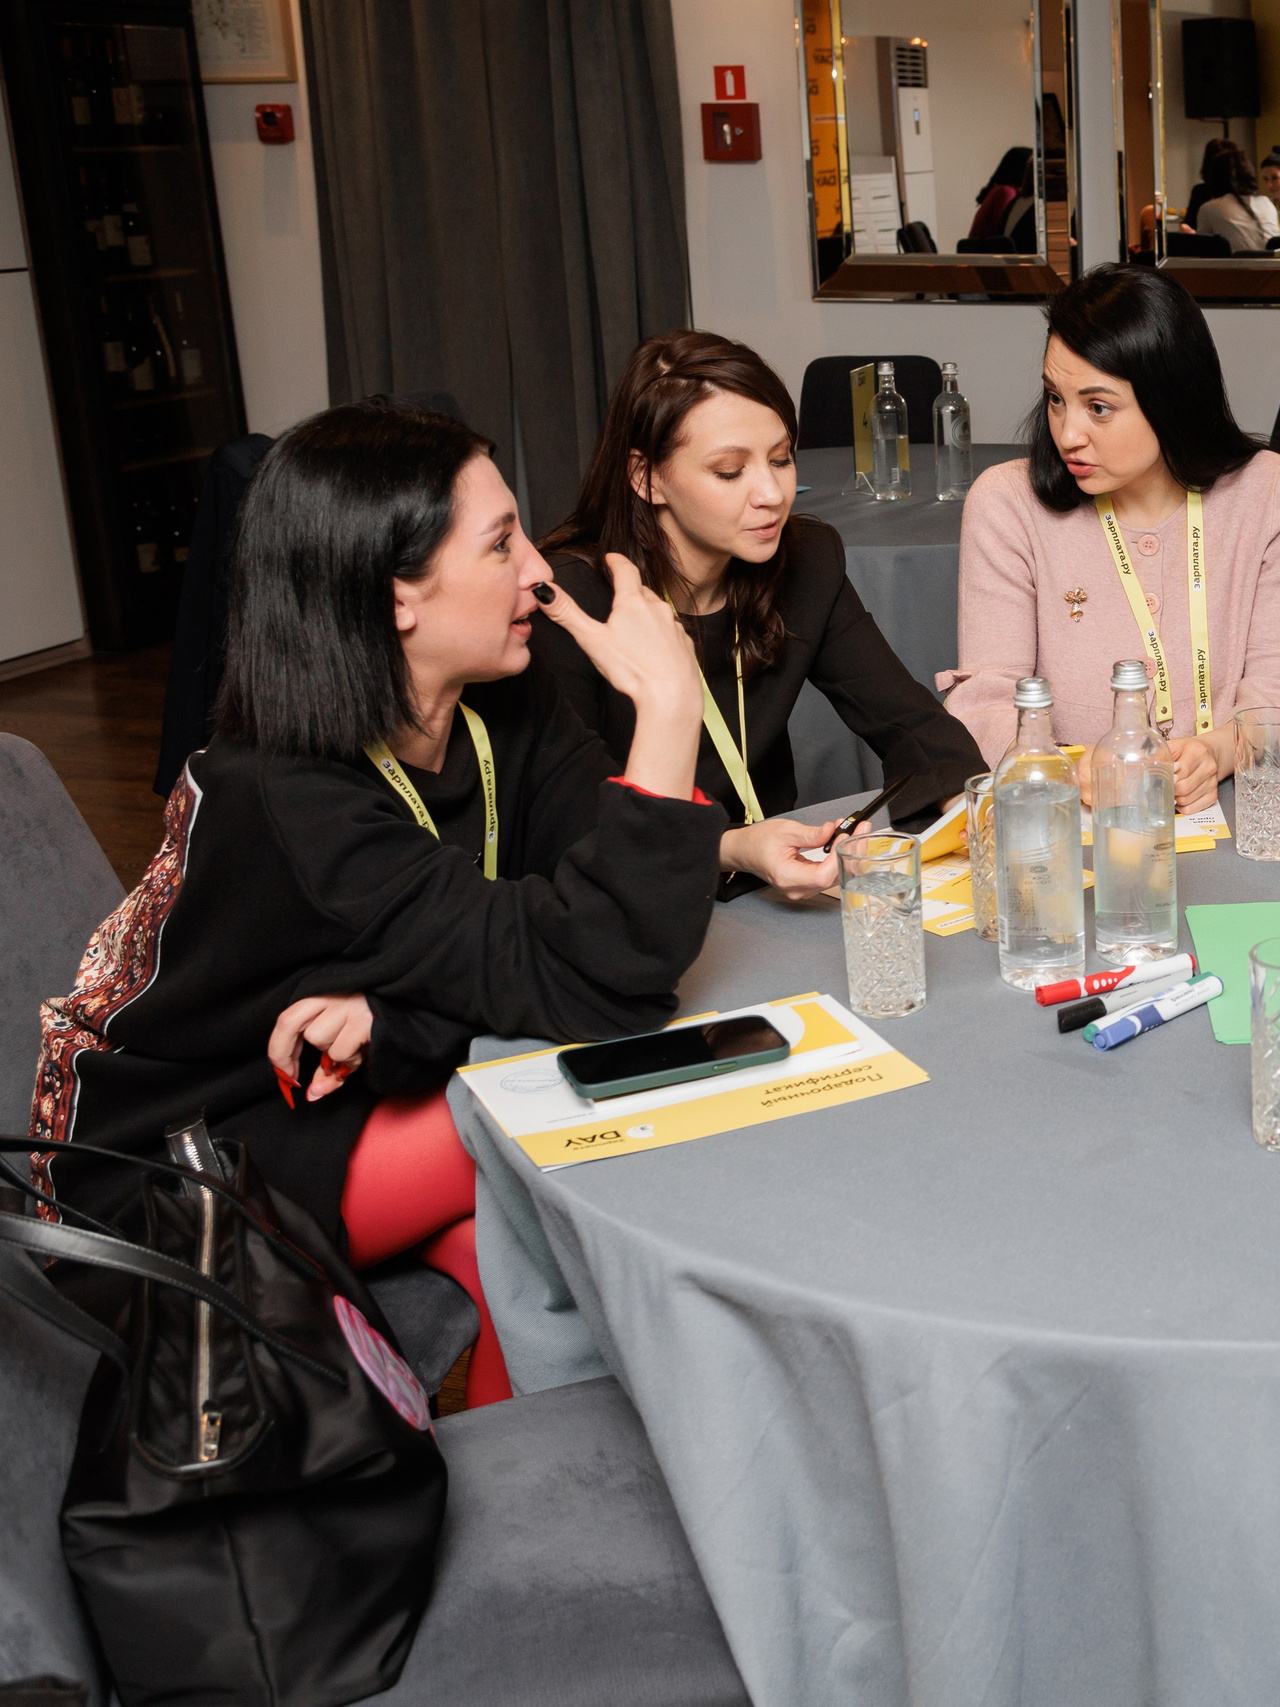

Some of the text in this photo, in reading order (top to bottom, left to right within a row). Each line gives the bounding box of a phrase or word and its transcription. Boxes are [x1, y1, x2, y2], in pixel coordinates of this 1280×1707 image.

[761, 1073, 883, 1107] Подарочный
[765, 1065, 872, 1095] сертификат
[564, 1130, 621, 1147] DAY
